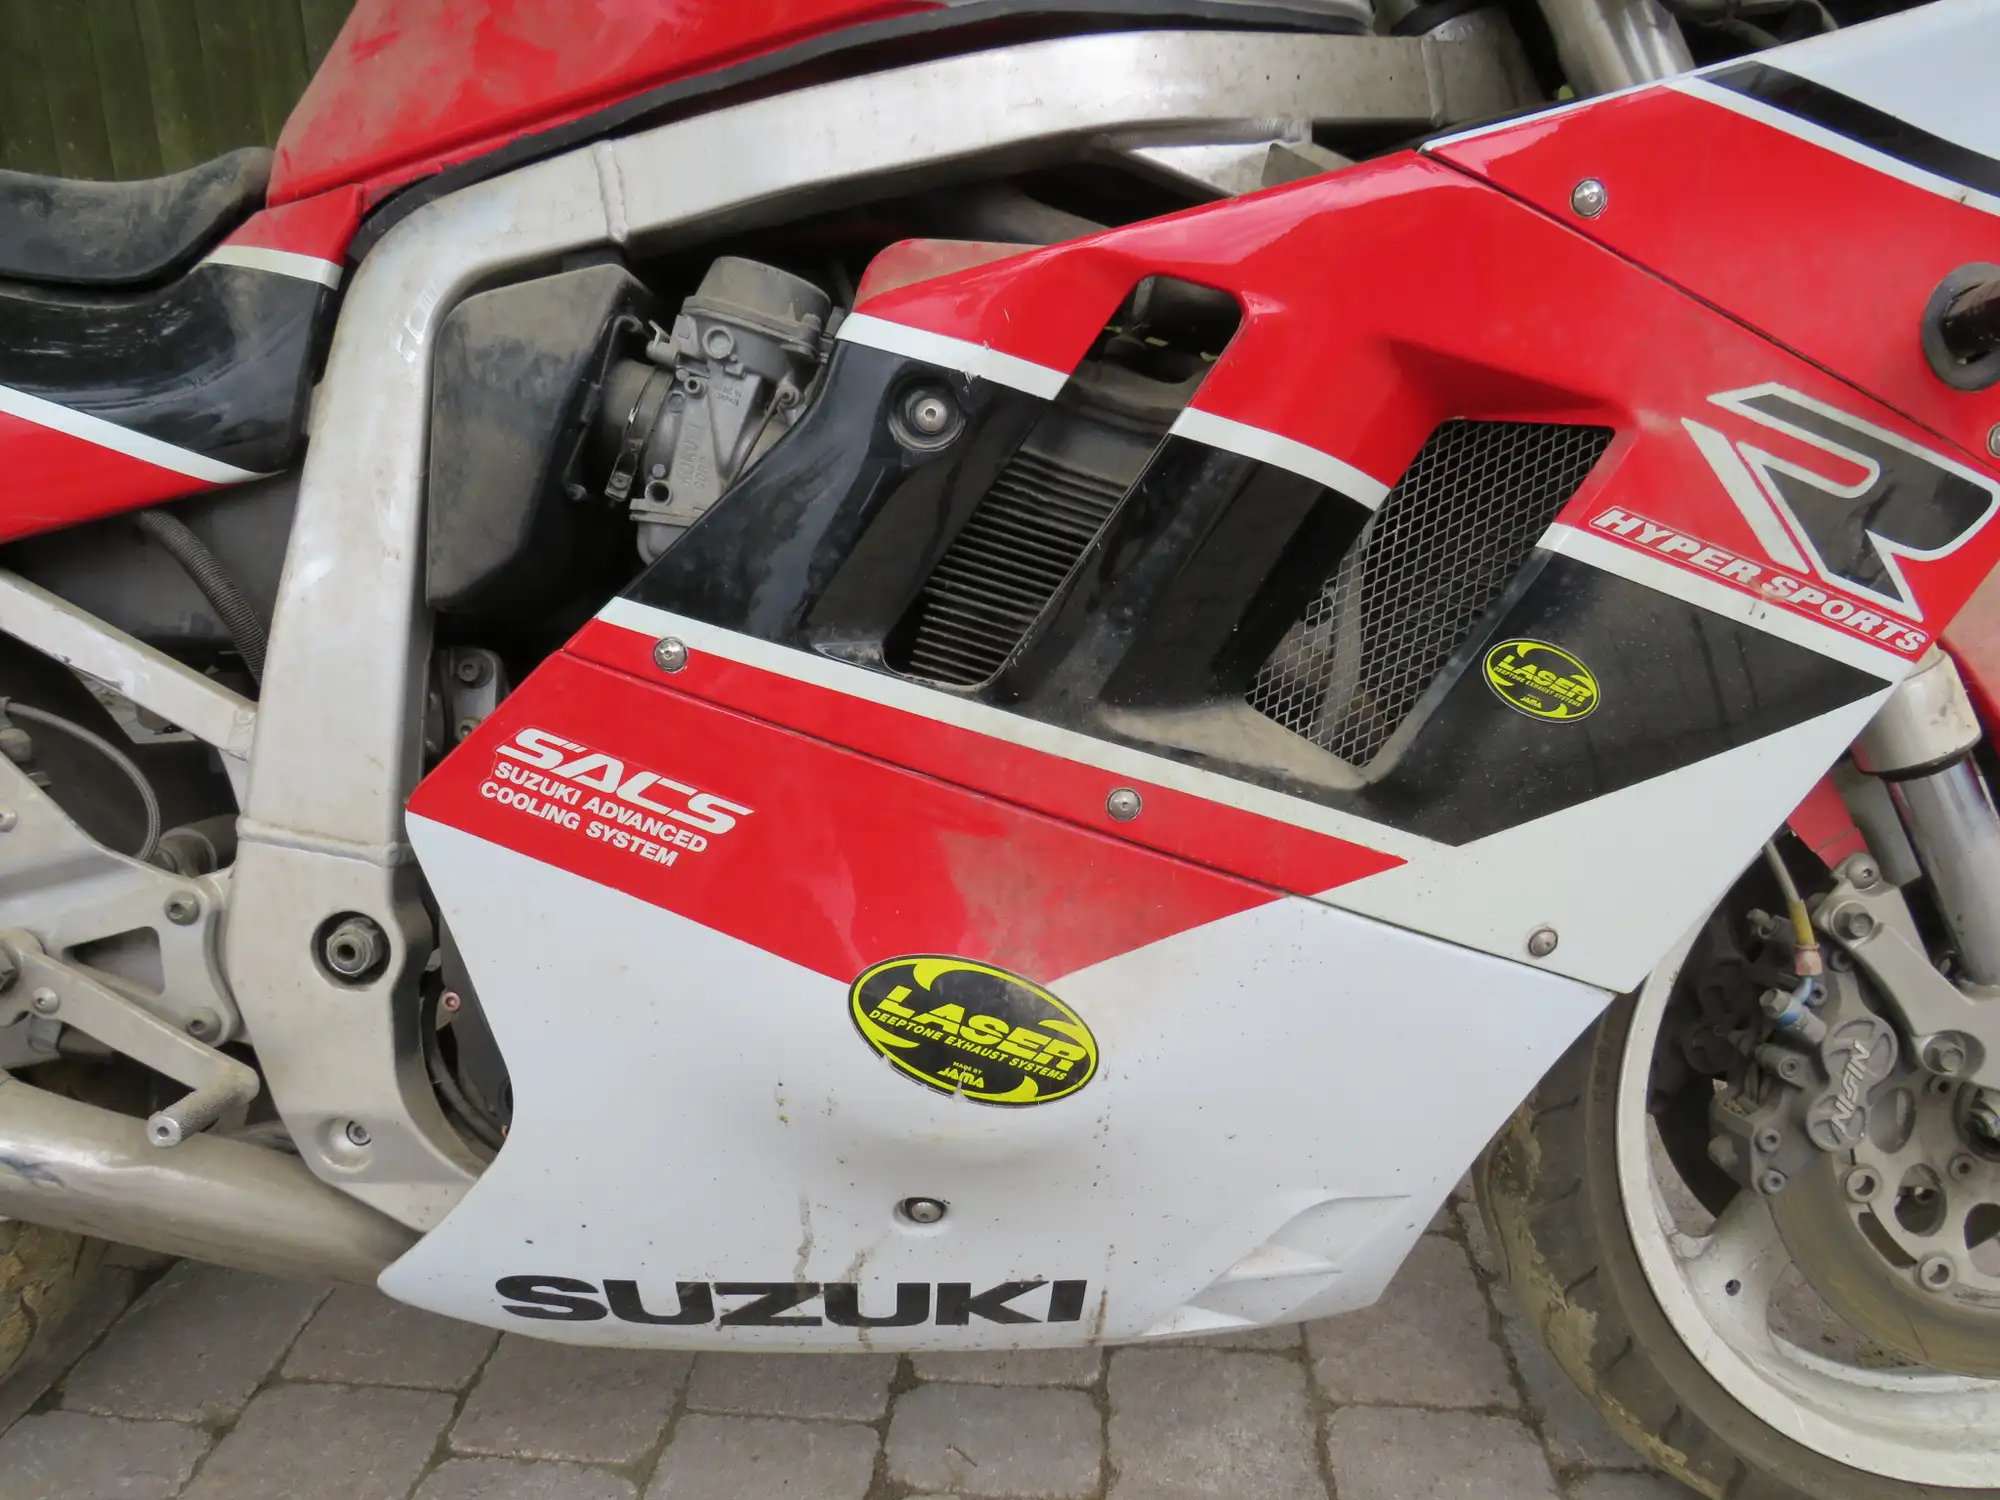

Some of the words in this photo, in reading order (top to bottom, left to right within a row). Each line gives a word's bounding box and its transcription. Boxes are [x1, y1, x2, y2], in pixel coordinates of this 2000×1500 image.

[1681, 381, 2000, 622] R
[1595, 509, 1763, 584] HYPER
[1761, 575, 1926, 652] SPORTS
[1498, 654, 1594, 703] LASER
[480, 781, 581, 831] COOLING
[585, 820, 679, 867] SYSTEM
[494, 761, 582, 806] SUZUKI
[582, 796, 708, 853] ADVANCED
[868, 1009, 944, 1041] DEEPTONE
[944, 1035, 1009, 1062] EXHAUST
[1008, 1057, 1068, 1081] SYSTEMS
[876, 984, 1087, 1072] LASER
[952, 1060, 973, 1072] MADE
[936, 1066, 985, 1089] JAMA
[495, 1274, 1088, 1327] SUZUKI
